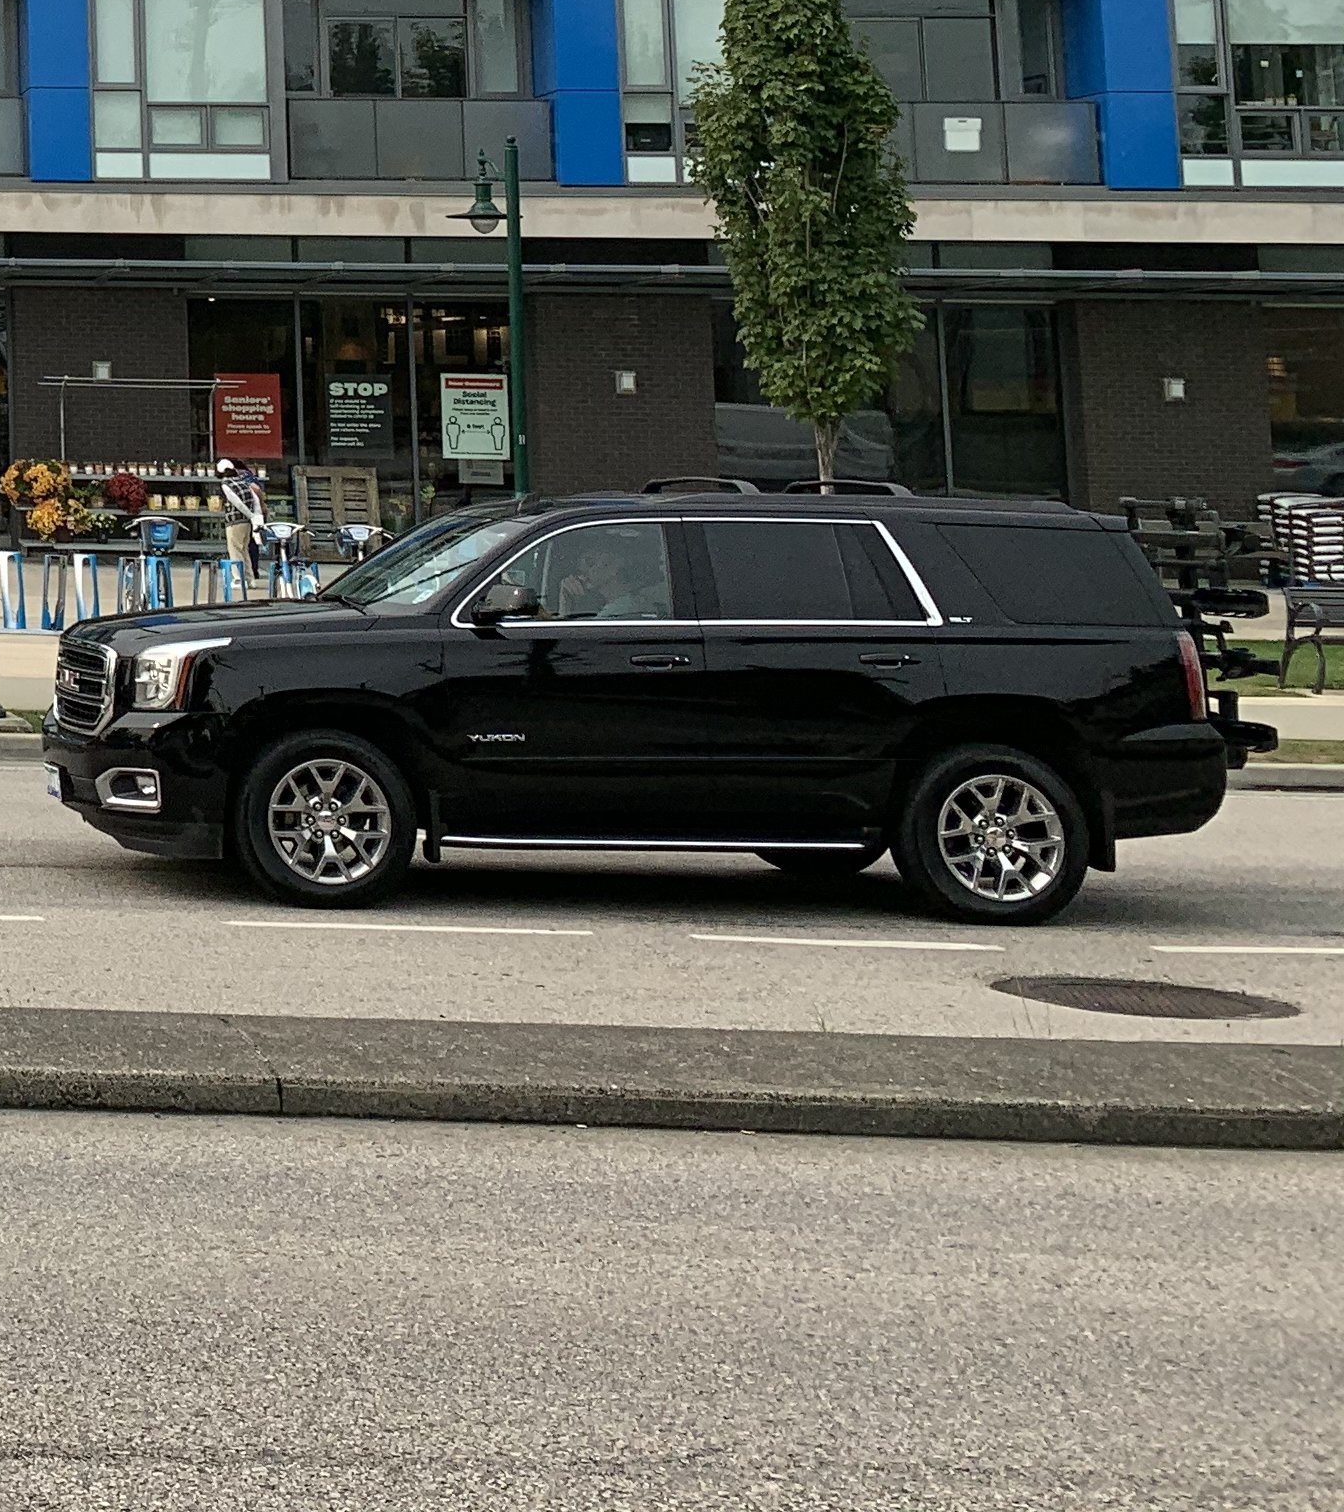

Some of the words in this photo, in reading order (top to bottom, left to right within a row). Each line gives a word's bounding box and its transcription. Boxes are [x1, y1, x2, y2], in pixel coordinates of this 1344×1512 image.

[328, 381, 388, 397] STOP
[453, 398, 497, 407] Distancing
[221, 404, 274, 414] shopping
[231, 413, 265, 421] hours
[466, 733, 526, 742] YUKON
